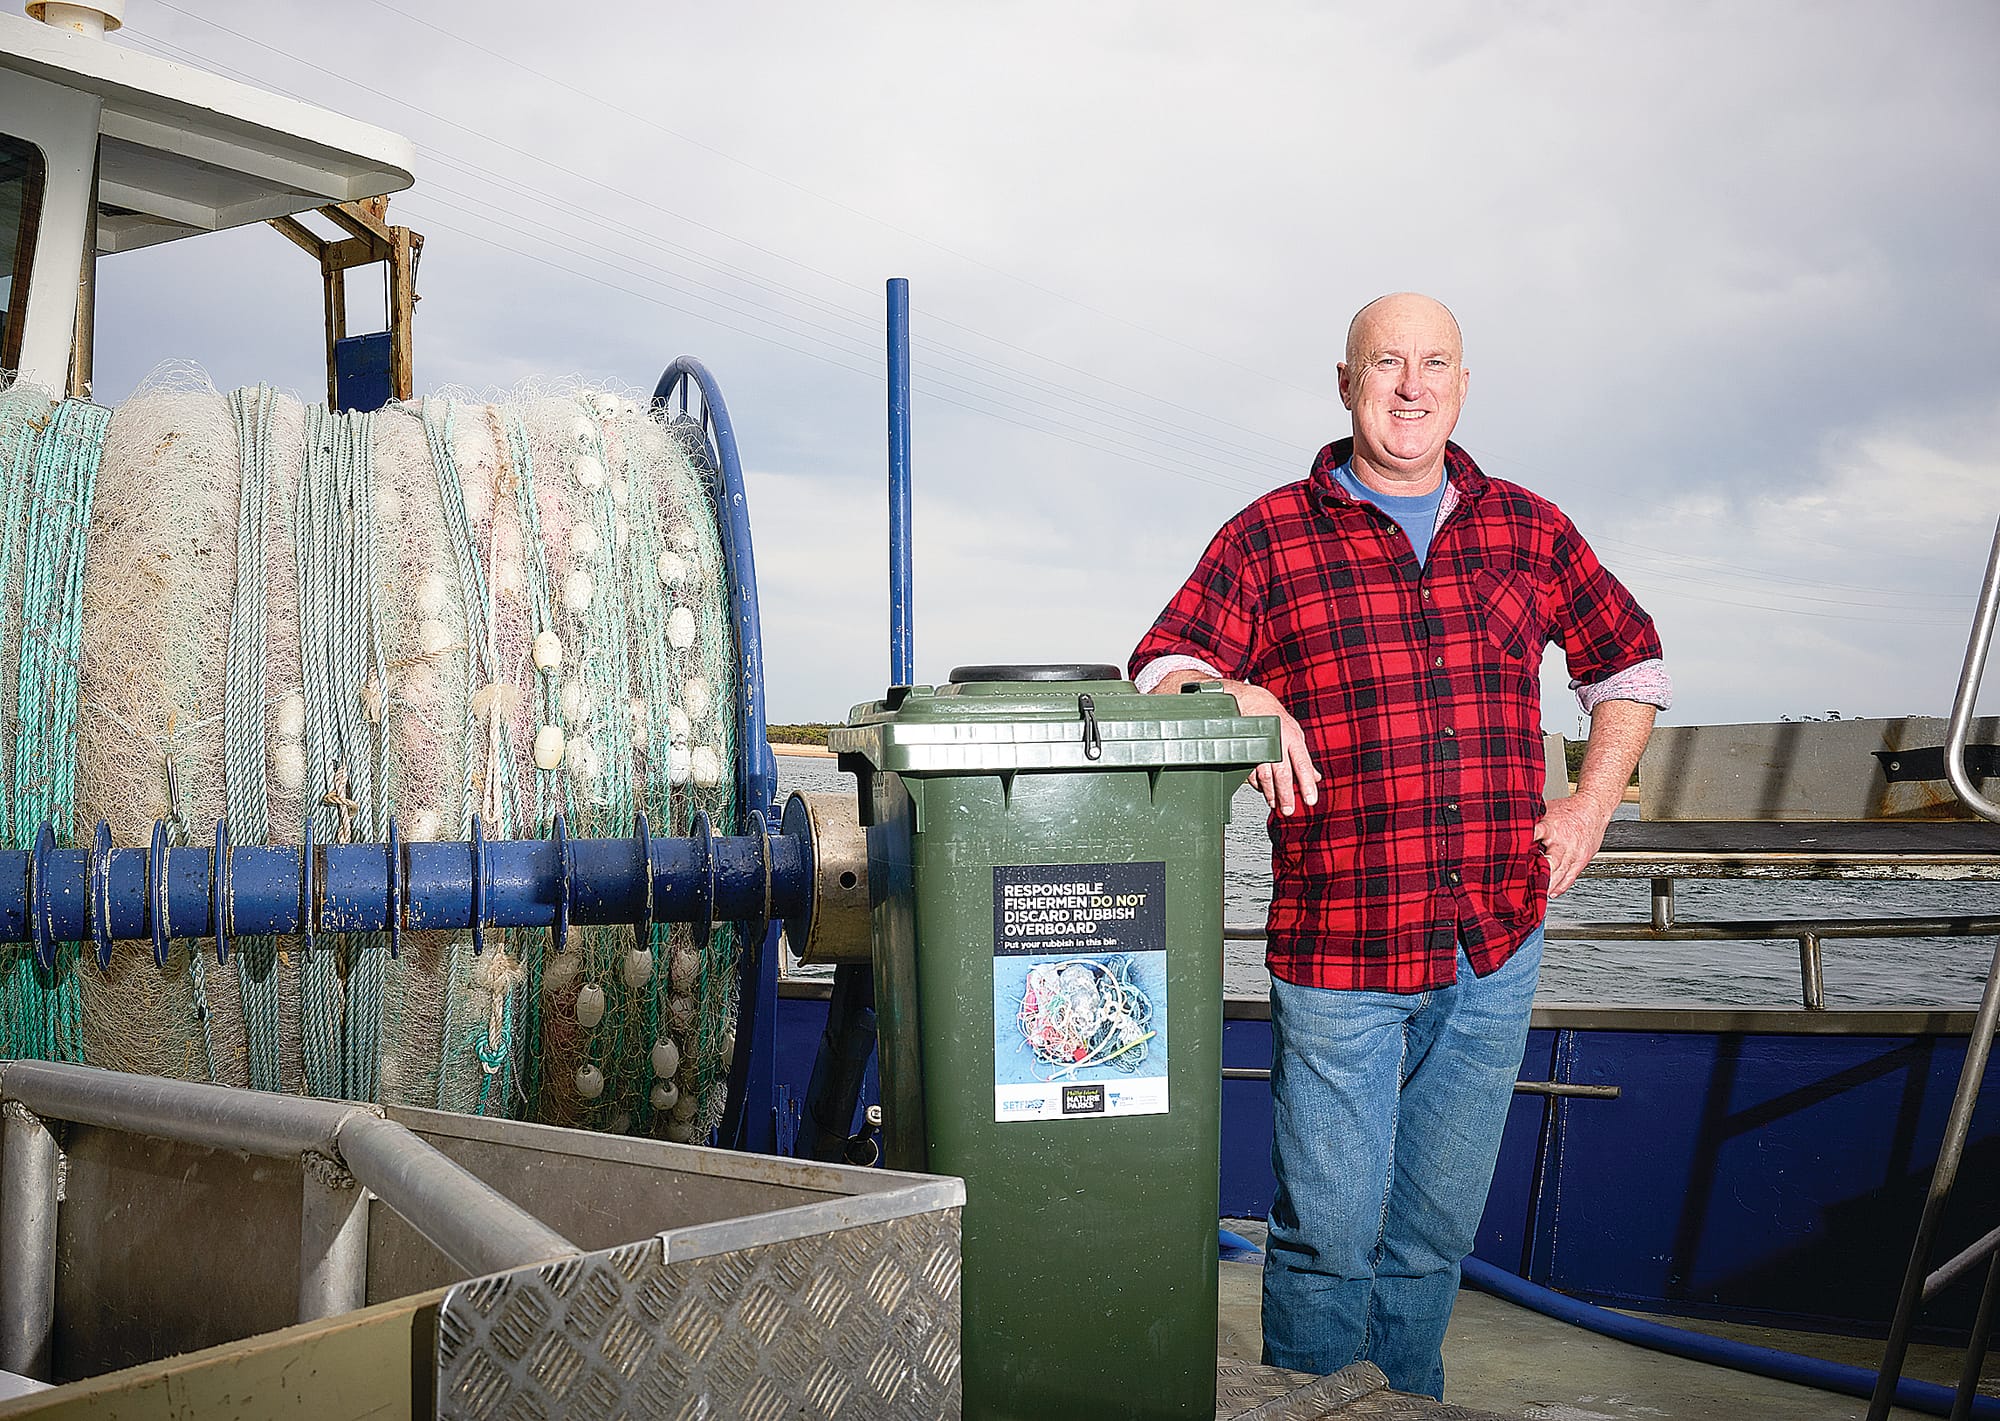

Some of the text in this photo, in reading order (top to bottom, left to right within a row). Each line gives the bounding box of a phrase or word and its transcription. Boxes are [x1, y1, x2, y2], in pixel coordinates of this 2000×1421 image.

[1004, 882, 1104, 897] RESPONSIBLE
[1004, 894, 1146, 910] FISHERMEN DO NOT
[1004, 908, 1135, 923] DISCARD RUBBISH
[1004, 922, 1097, 936] OVERBOARD
[1004, 938, 1117, 950] Put your rubbish in this bin
[1066, 1094, 1101, 1103] NATURE
[1066, 1101, 1095, 1110] PARKS
